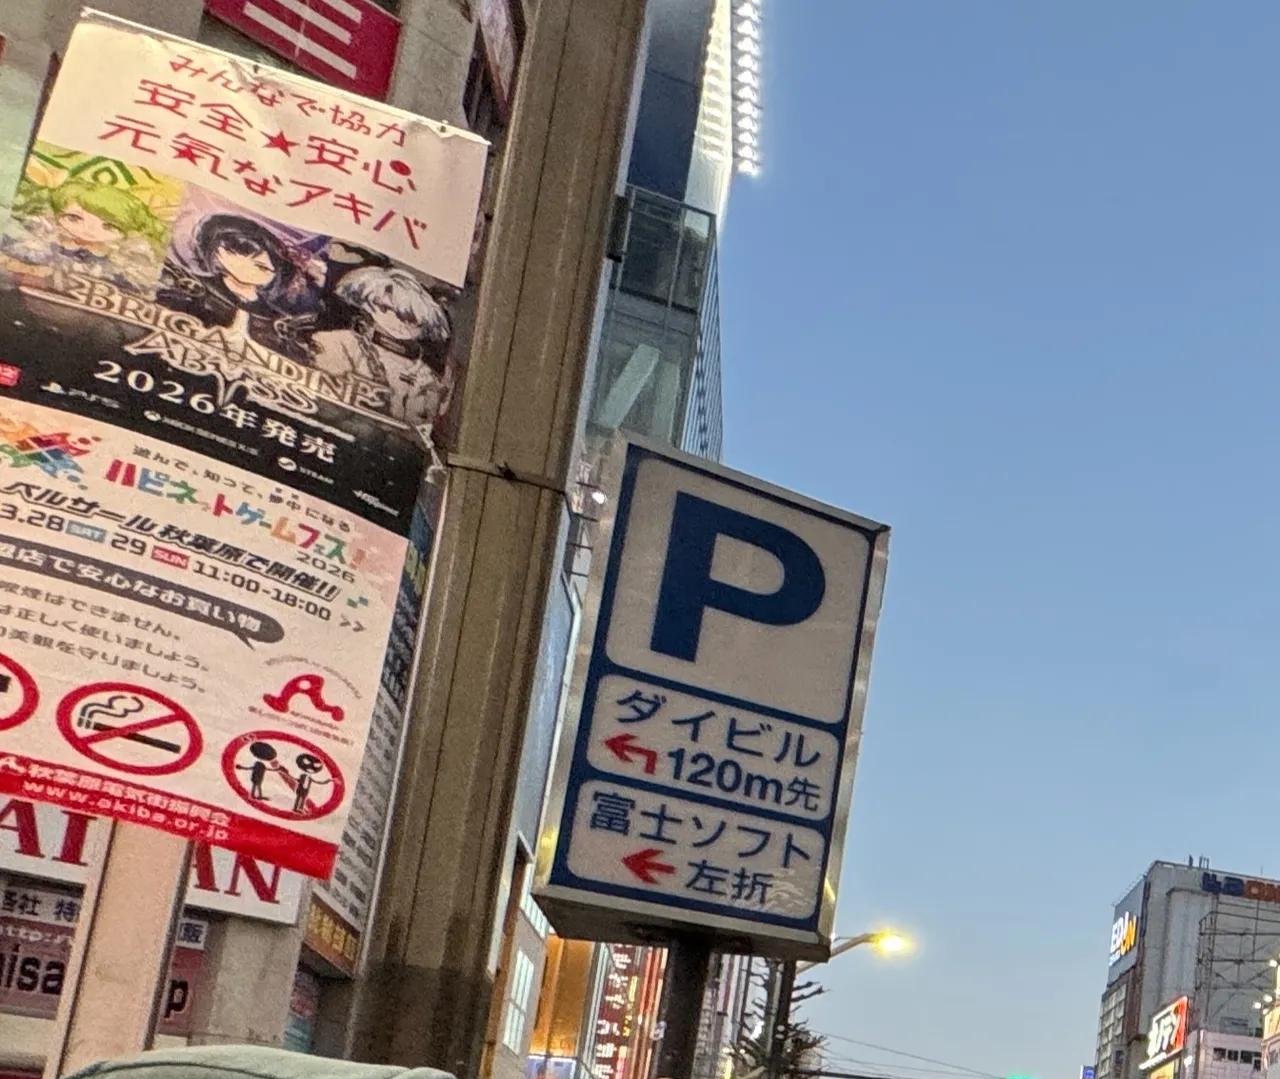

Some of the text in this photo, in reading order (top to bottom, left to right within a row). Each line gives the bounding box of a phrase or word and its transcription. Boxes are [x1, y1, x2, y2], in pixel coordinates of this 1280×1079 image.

[170, 54, 407, 147] みんなで協力
[98, 114, 428, 249] 元気なアキバ
[95, 360, 337, 464] 2026年発売
[111, 532, 147, 557] 29
[153, 549, 187, 567] SUN
[193, 560, 331, 621] 11:00-18:00
[296, 550, 356, 584] 2026
[651, 491, 825, 663] P
[616, 690, 821, 768] ダイビル
[668, 747, 822, 812] 120m先
[589, 792, 812, 870] 富士ソフト
[686, 858, 774, 904] 左折
